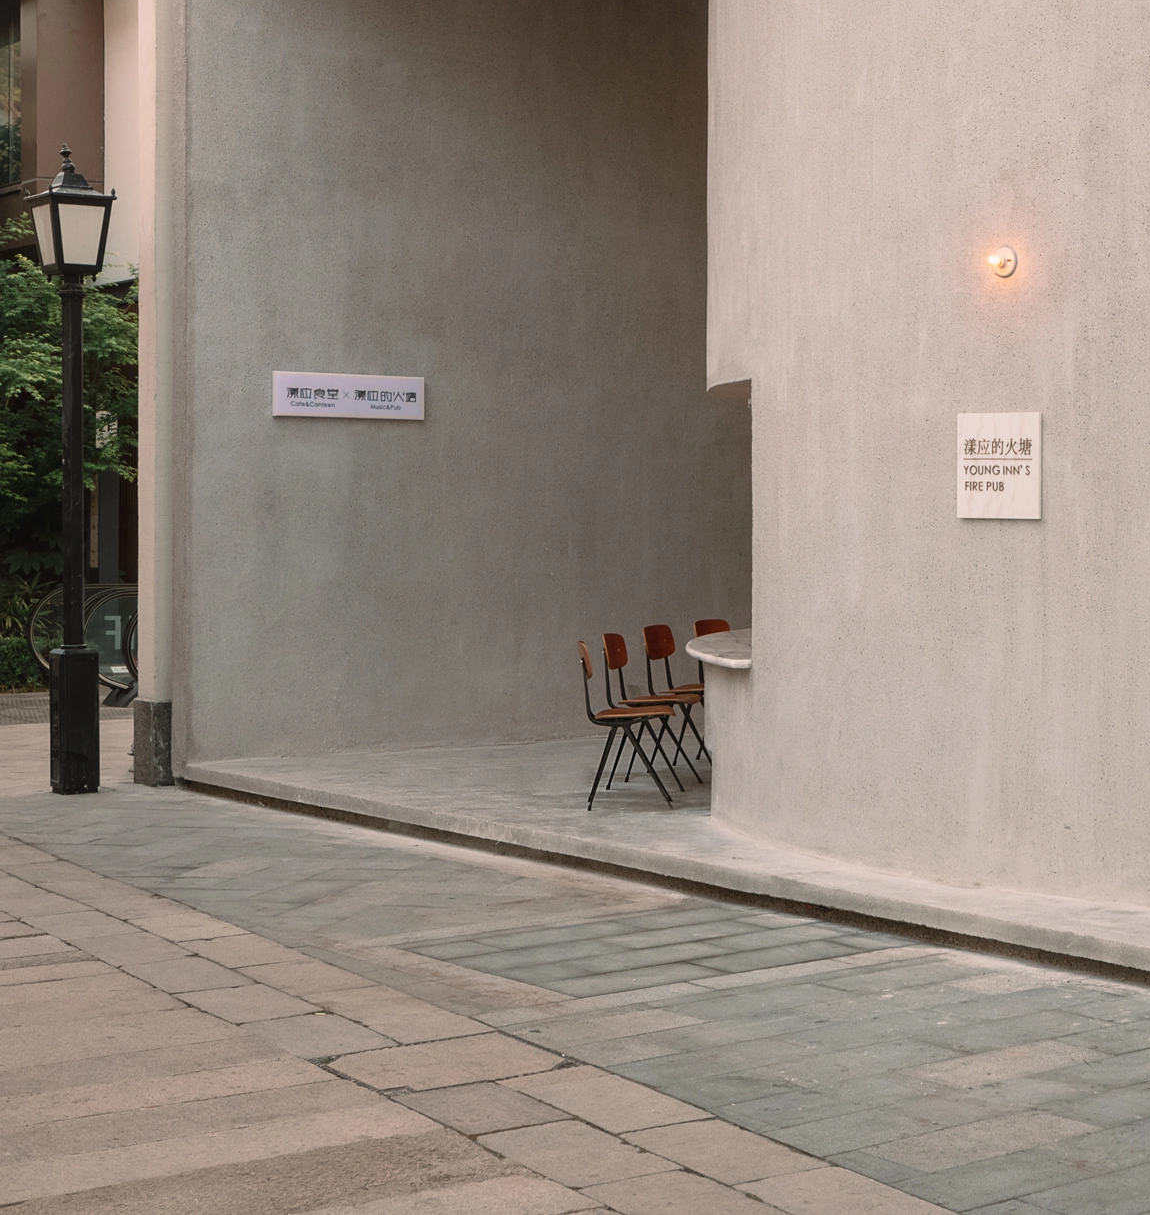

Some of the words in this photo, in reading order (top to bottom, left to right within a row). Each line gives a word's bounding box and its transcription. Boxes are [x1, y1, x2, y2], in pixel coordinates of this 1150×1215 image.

[963, 464, 1000, 475] YOUNG
[964, 481, 984, 491] FIRE
[986, 481, 1004, 491] PUB
